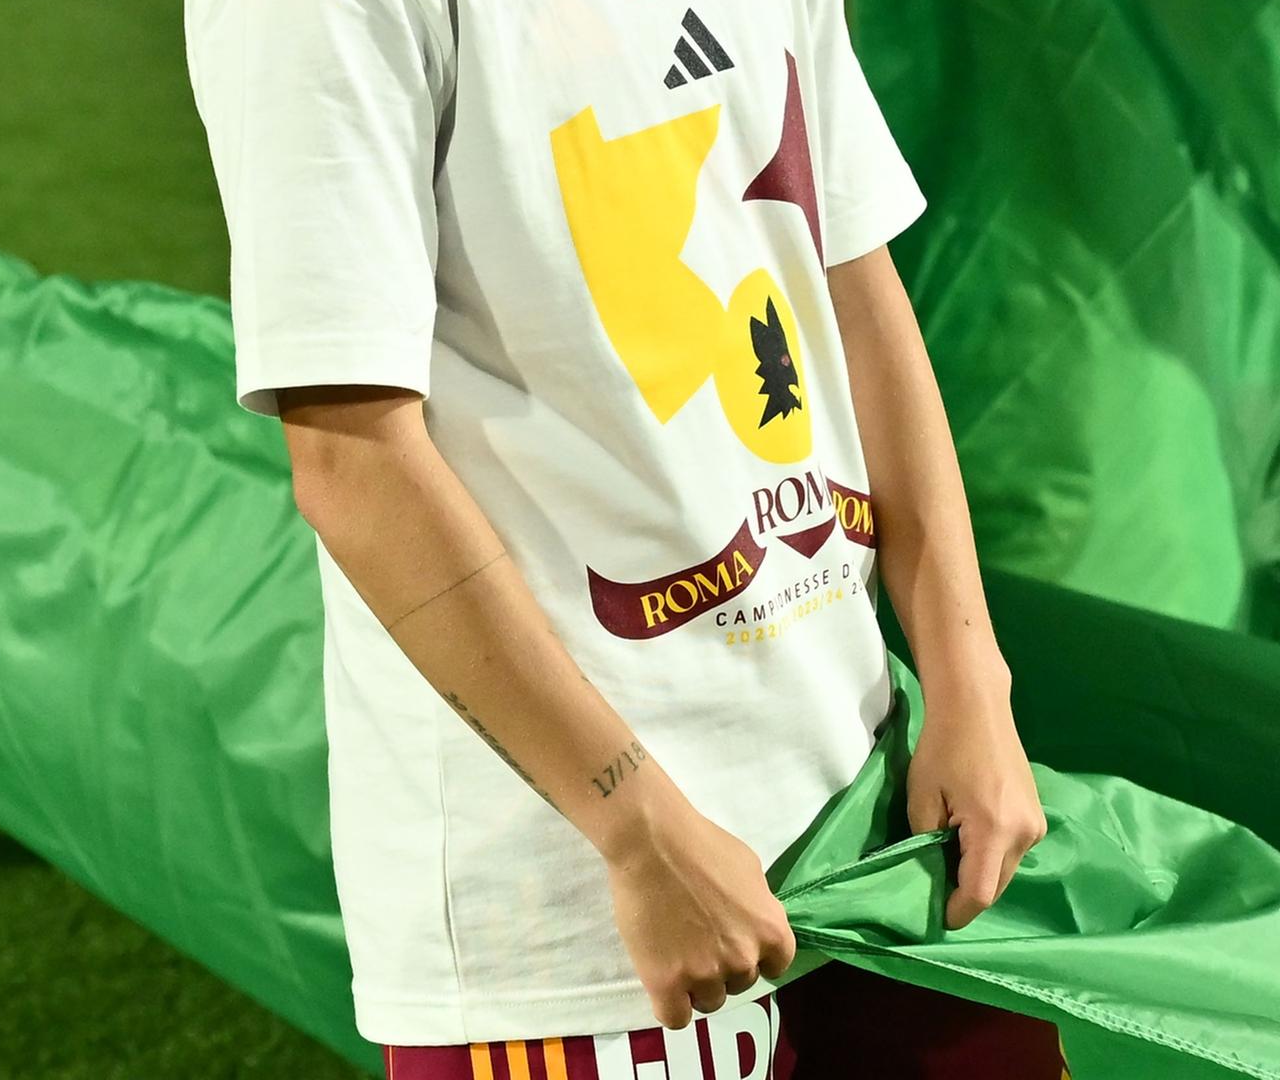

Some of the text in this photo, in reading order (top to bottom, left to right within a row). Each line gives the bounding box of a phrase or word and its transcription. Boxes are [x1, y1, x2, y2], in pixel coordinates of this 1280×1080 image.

[752, 467, 833, 536] ROM
[832, 489, 875, 536] ROM
[639, 549, 756, 630] ROMA
[591, 741, 647, 799] 17/18
